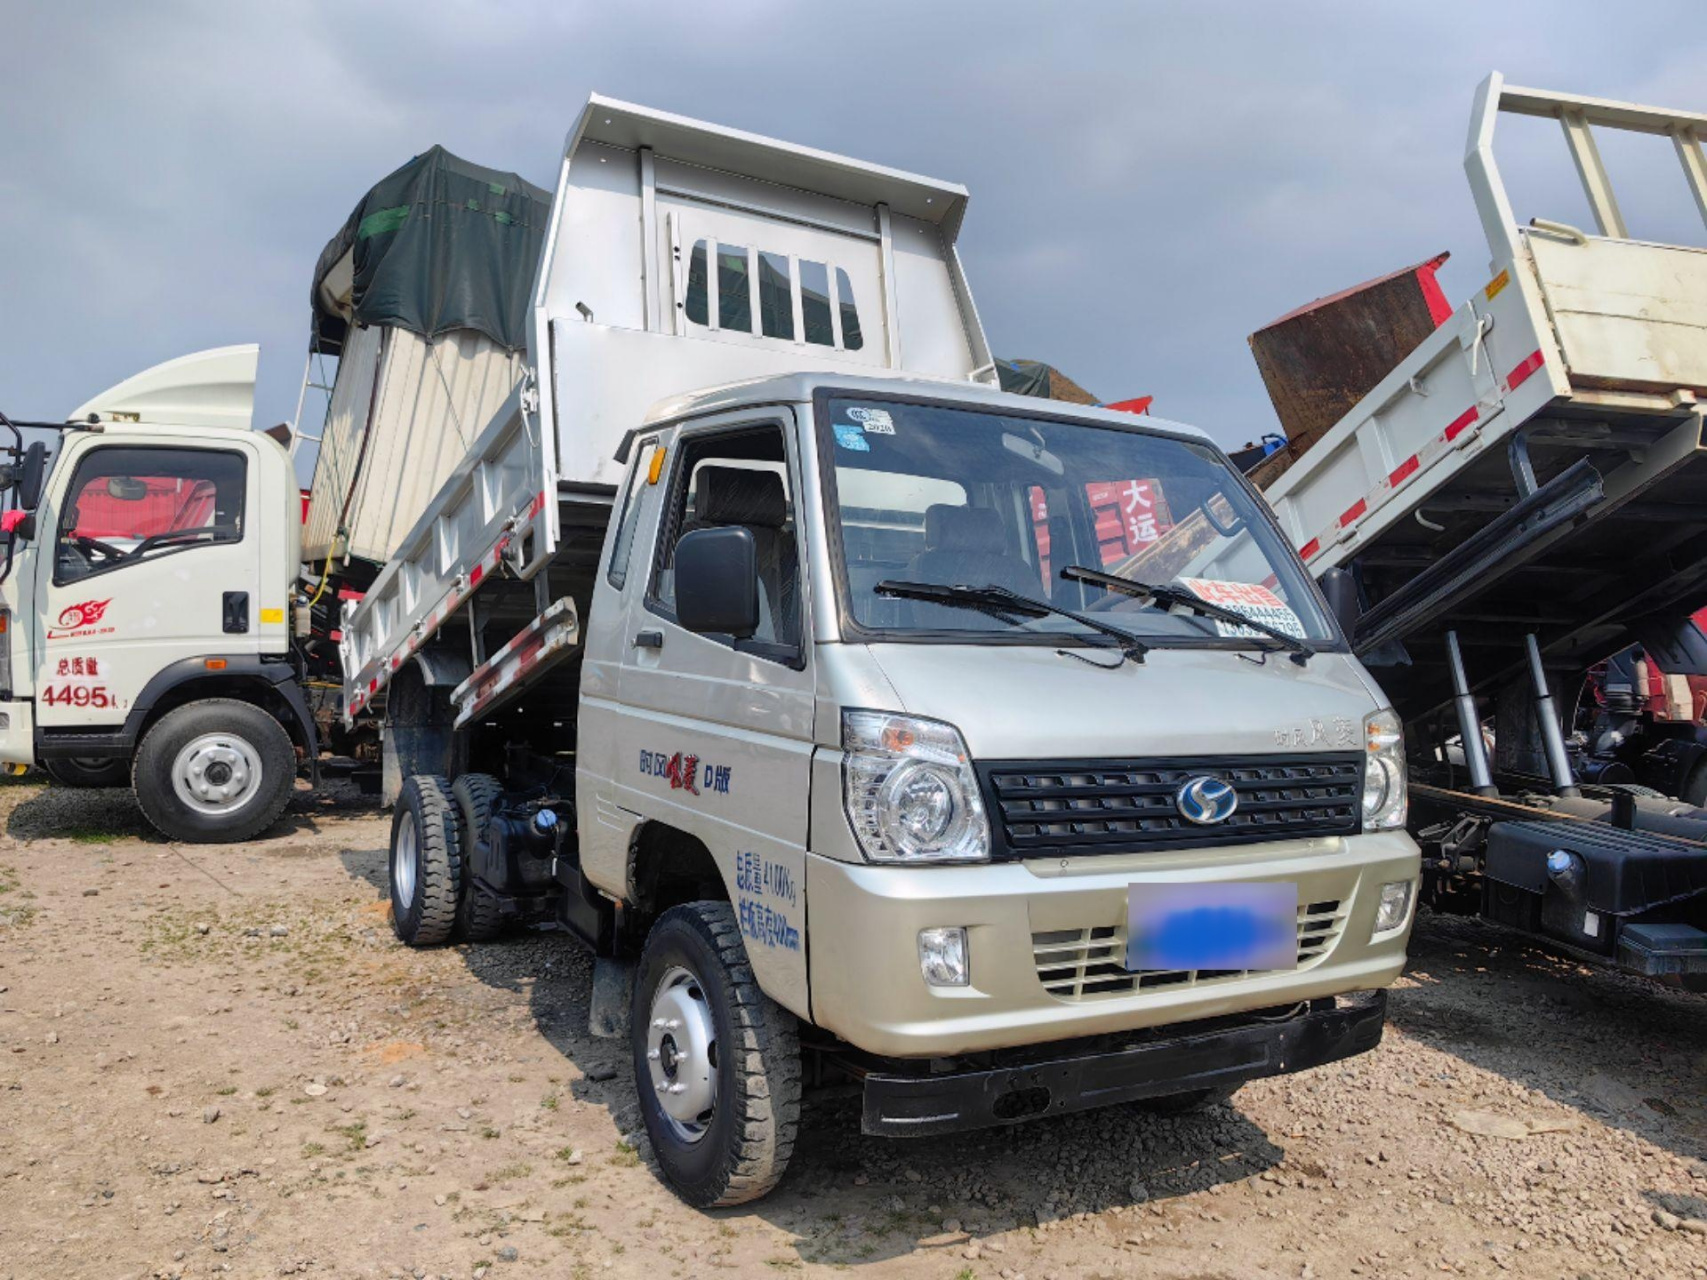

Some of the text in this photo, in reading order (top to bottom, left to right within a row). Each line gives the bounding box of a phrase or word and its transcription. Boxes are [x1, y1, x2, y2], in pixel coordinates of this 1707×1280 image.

[1122, 479, 1159, 545] 大运
[57, 657, 99, 676] 总质量
